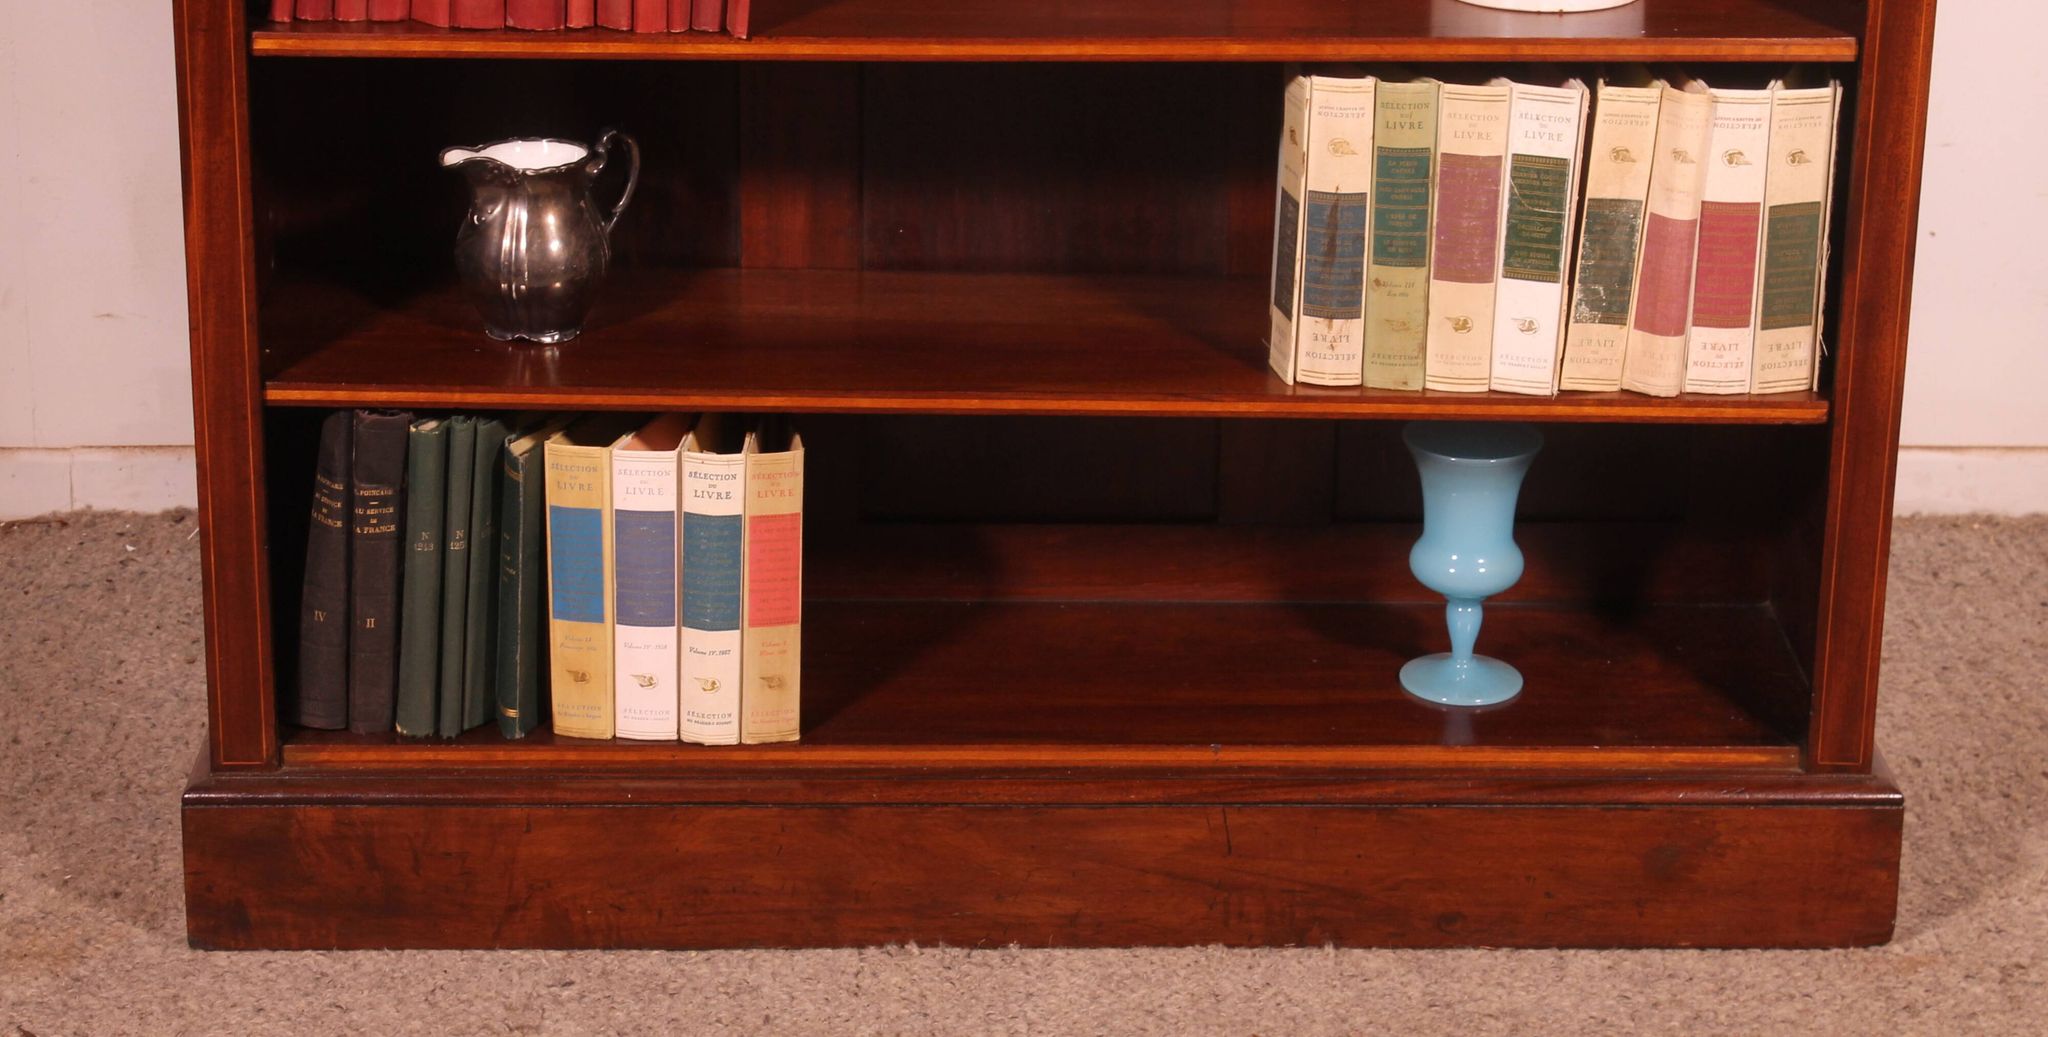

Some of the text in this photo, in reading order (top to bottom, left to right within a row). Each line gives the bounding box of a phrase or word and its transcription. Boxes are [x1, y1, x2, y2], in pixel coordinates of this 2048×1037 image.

[1386, 121, 1424, 130] LIVRE
[1454, 130, 1492, 140] LIVRE
[1524, 130, 1564, 142] LIVRE
[1312, 333, 1350, 344] LIVRE
[1701, 342, 1740, 352] LIVRE
[1768, 341, 1803, 352] LIVRE
[557, 480, 594, 492] LIVRE
[625, 487, 665, 496] LIVRE
[693, 489, 732, 500] LIVRE
[757, 488, 796, 499] LIVRE
[363, 524, 396, 534] FRANCE
[455, 529, 464, 540] N
[366, 618, 376, 628] II
